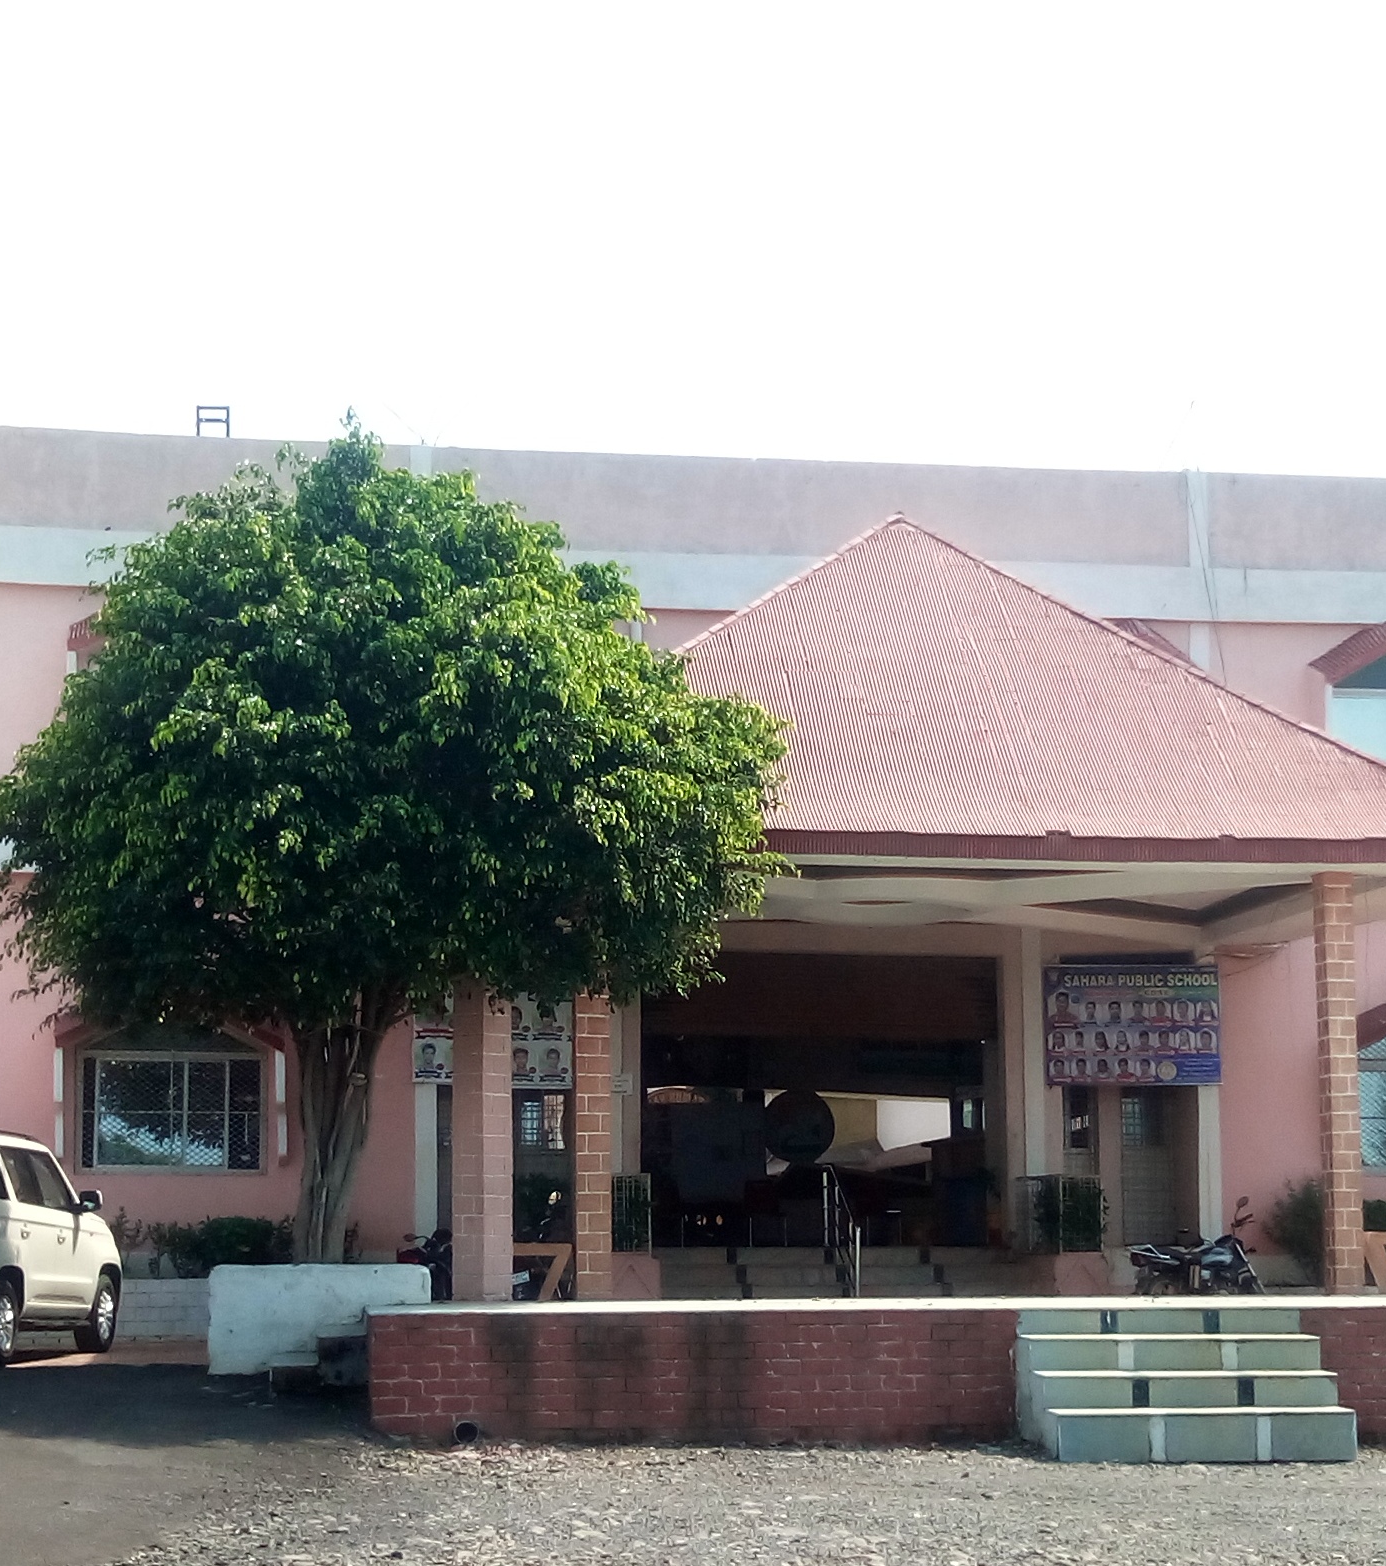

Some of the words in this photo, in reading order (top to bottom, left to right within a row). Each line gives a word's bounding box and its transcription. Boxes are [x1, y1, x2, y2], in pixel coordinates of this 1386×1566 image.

[1064, 975, 1113, 987] SAHARA
[1118, 974, 1164, 987] PUBLIC
[1166, 974, 1217, 987] SCHOOL
